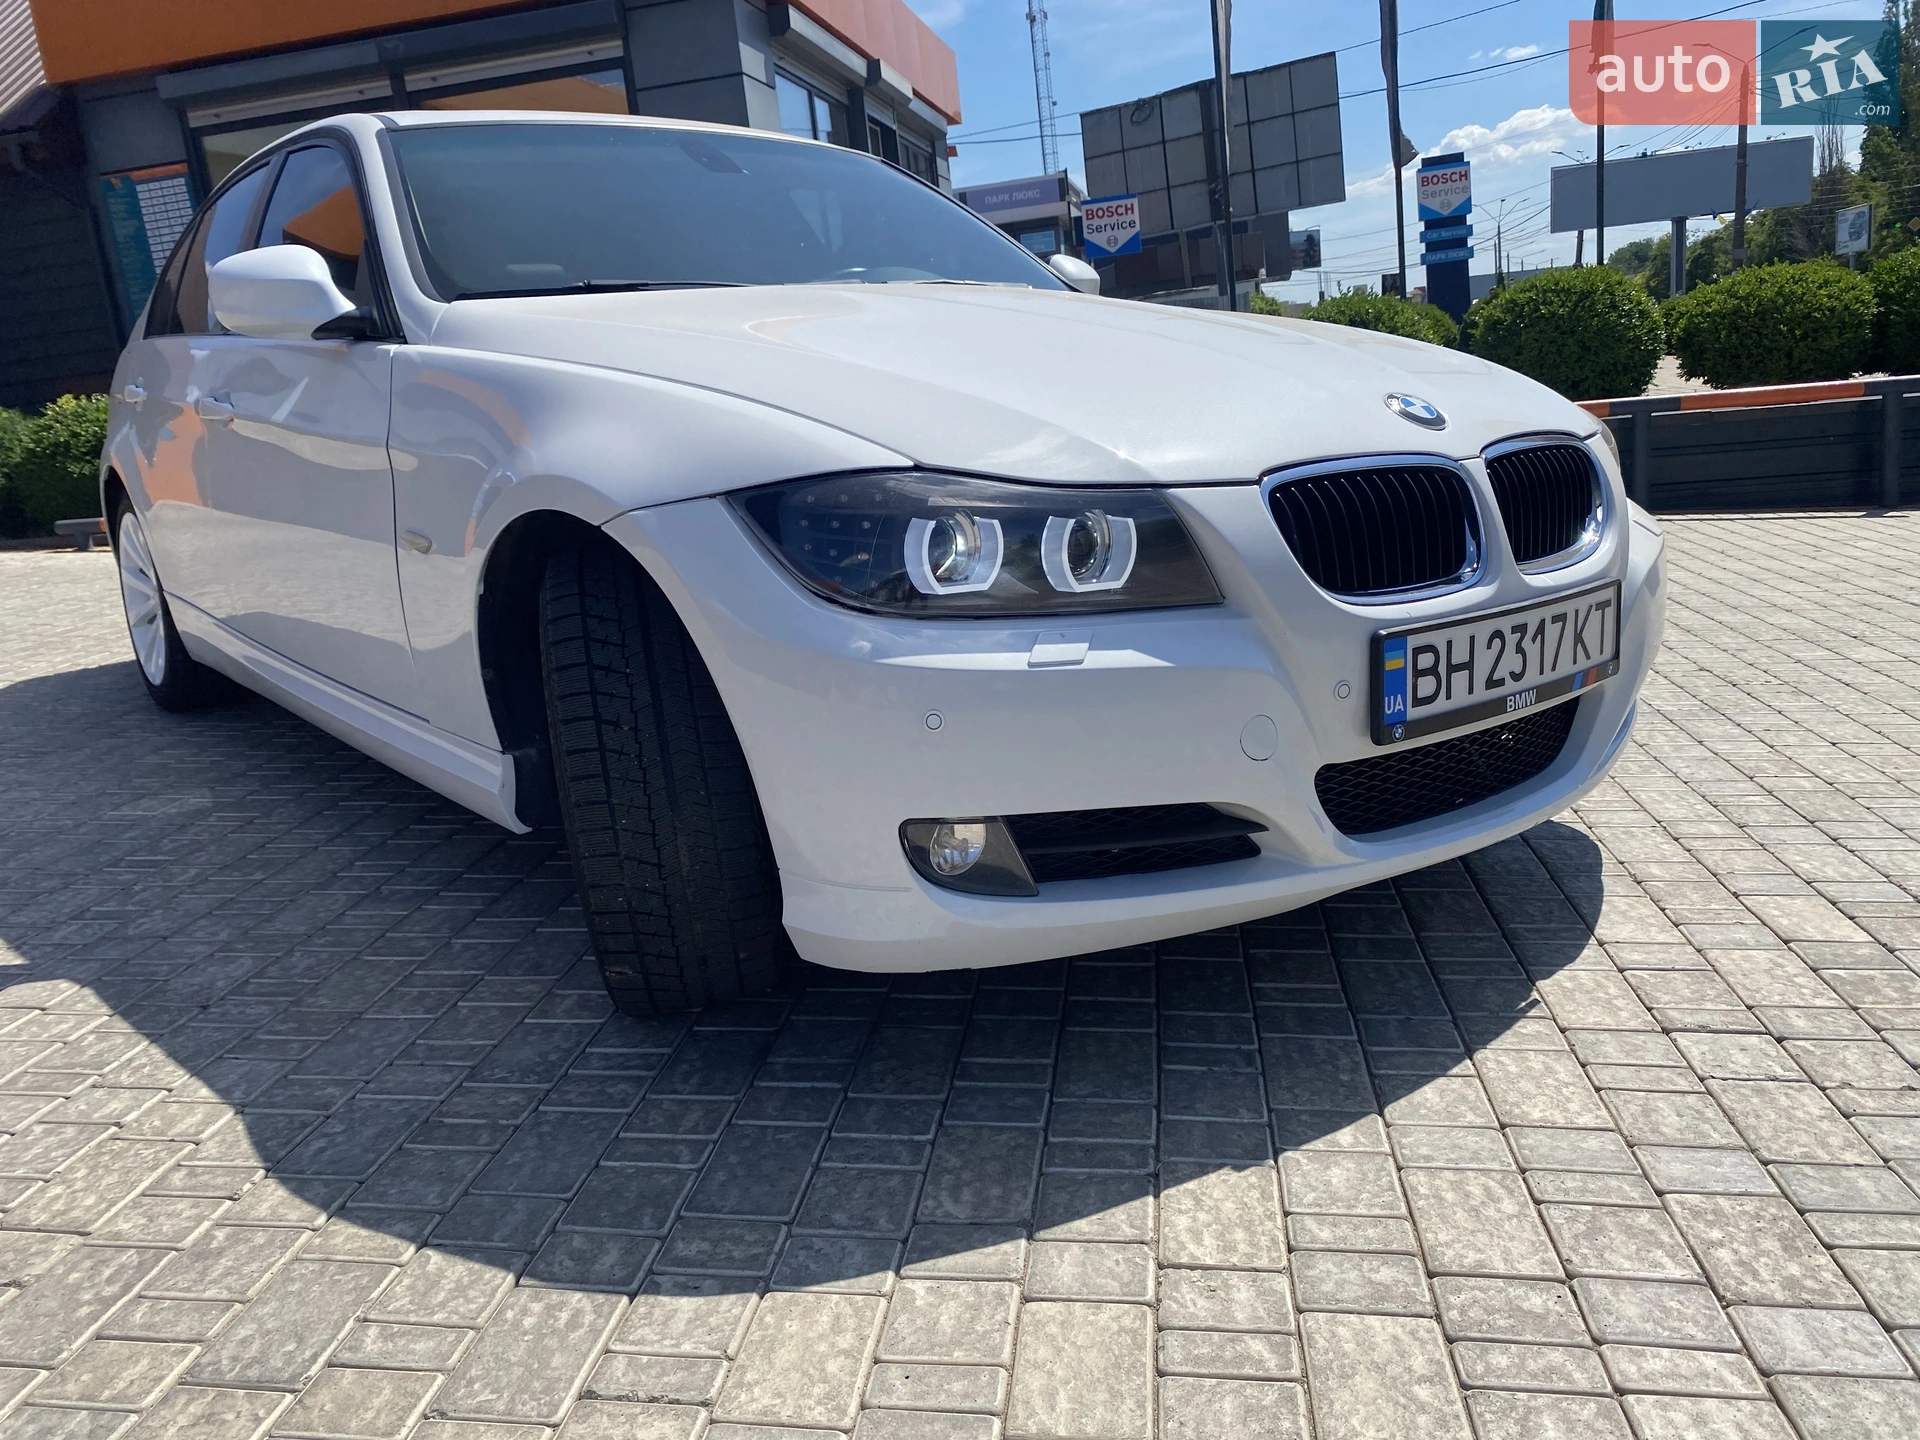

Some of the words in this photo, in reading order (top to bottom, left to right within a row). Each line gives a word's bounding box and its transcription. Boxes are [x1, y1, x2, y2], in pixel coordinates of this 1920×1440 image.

[1421, 170, 1468, 187] BOSCH
[984, 193, 1010, 205] ПАРК
[1012, 189, 1041, 201] ЛЮКС
[1421, 185, 1469, 199] Service
[1085, 202, 1135, 221] BOSCH
[1086, 218, 1137, 235] Service
[1426, 253, 1446, 262] ПАРК
[1384, 694, 1405, 714] UA
[1506, 689, 1537, 712] BMW
